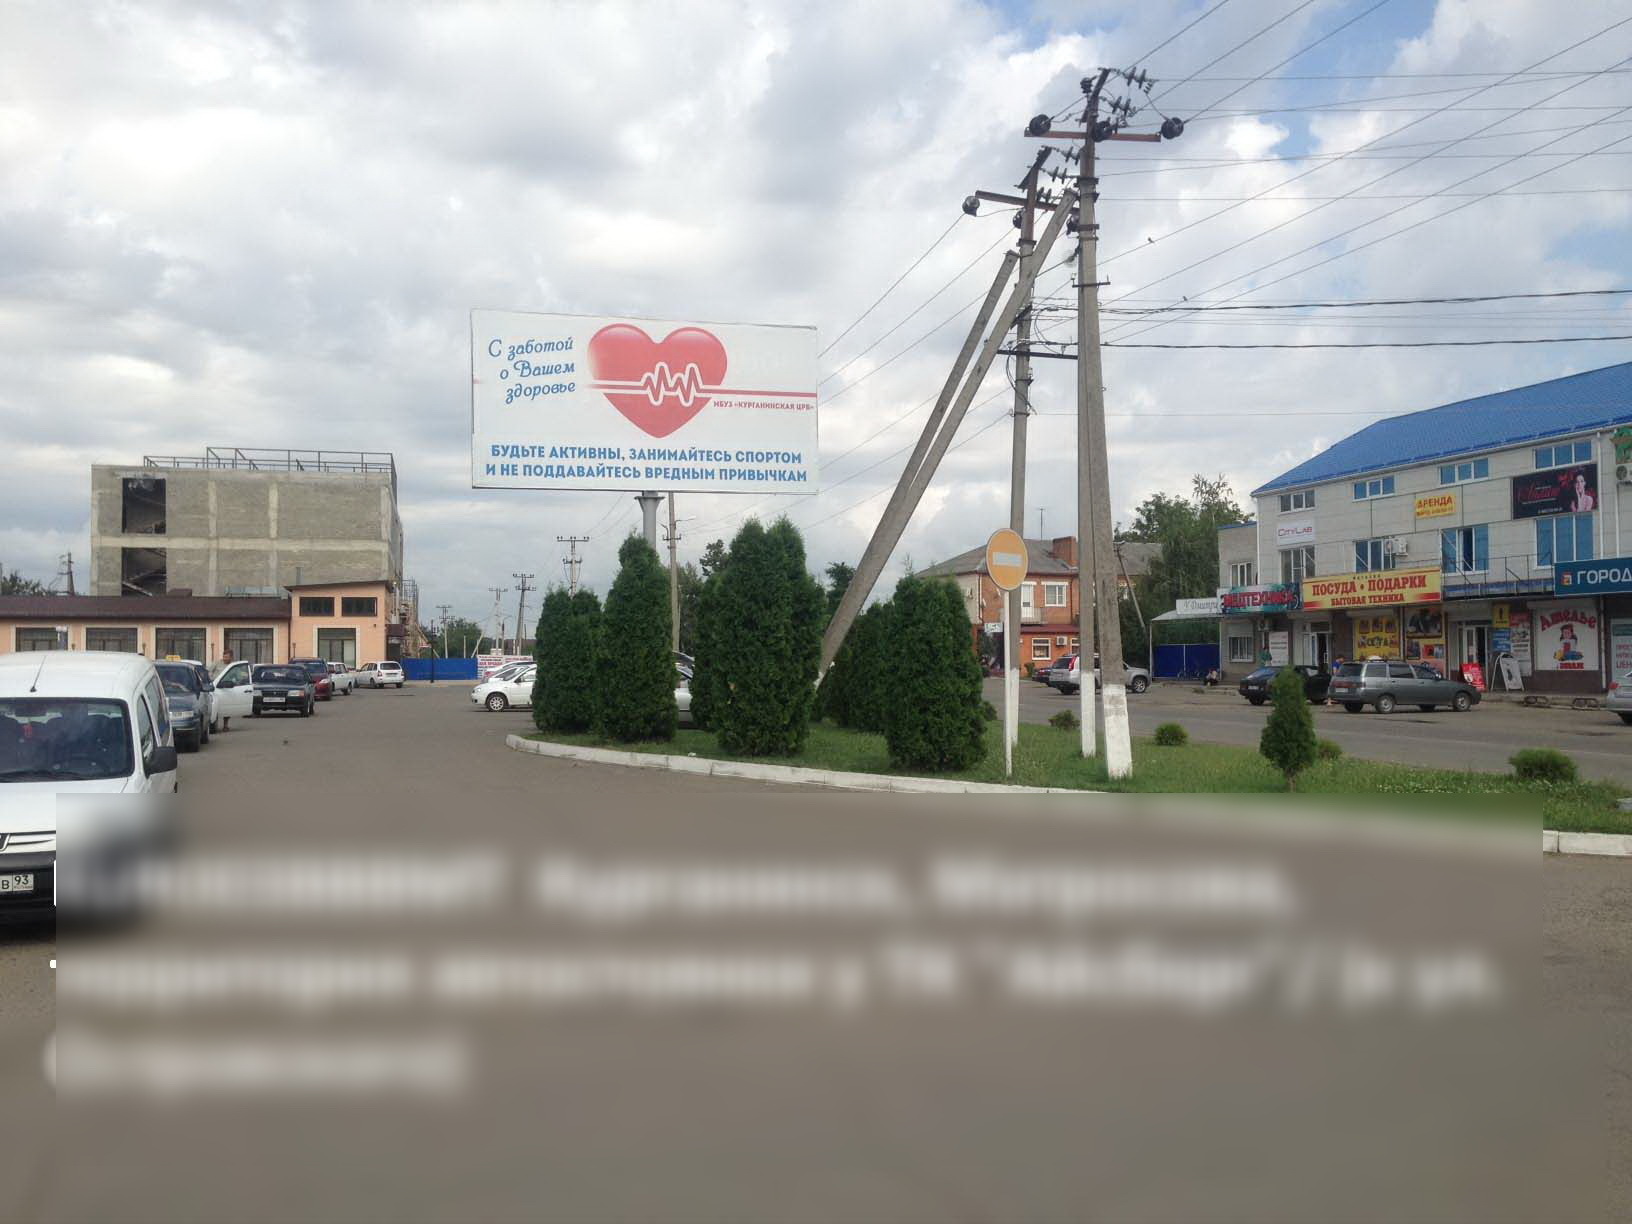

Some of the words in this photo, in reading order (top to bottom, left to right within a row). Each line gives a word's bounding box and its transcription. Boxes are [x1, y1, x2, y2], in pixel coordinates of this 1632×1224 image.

[488, 338, 502, 357] С
[507, 336, 574, 361] заботой
[500, 368, 509, 380] о
[513, 359, 575, 378] Вашем
[505, 382, 576, 405] здоровье
[491, 444, 545, 459] БУДЬТЕ
[550, 446, 625, 461] АКТИВНЫ,
[629, 446, 732, 462] ЗАНИМАЙТЕСЬ
[735, 449, 802, 464] СПОРТОМ
[486, 463, 496, 476] И
[500, 463, 518, 477] НЕ
[523, 463, 641, 479] ПОДДАВАЙТЕСЬ
[645, 466, 715, 481] ВРЕДНЫМ
[719, 468, 807, 482] ПРИВЫЧКАМ
[1417, 495, 1453, 509] АРЕНДА
[1312, 580, 1357, 596] ПОСУДА
[1367, 575, 1427, 593] ПОДАРКИ
[1577, 567, 1632, 585] ГОРОД
[1330, 595, 1367, 607] БЫТОВАЯ
[1367, 592, 1405, 604] ТЕХНИКА
[14, 874, 29, 886] 93
